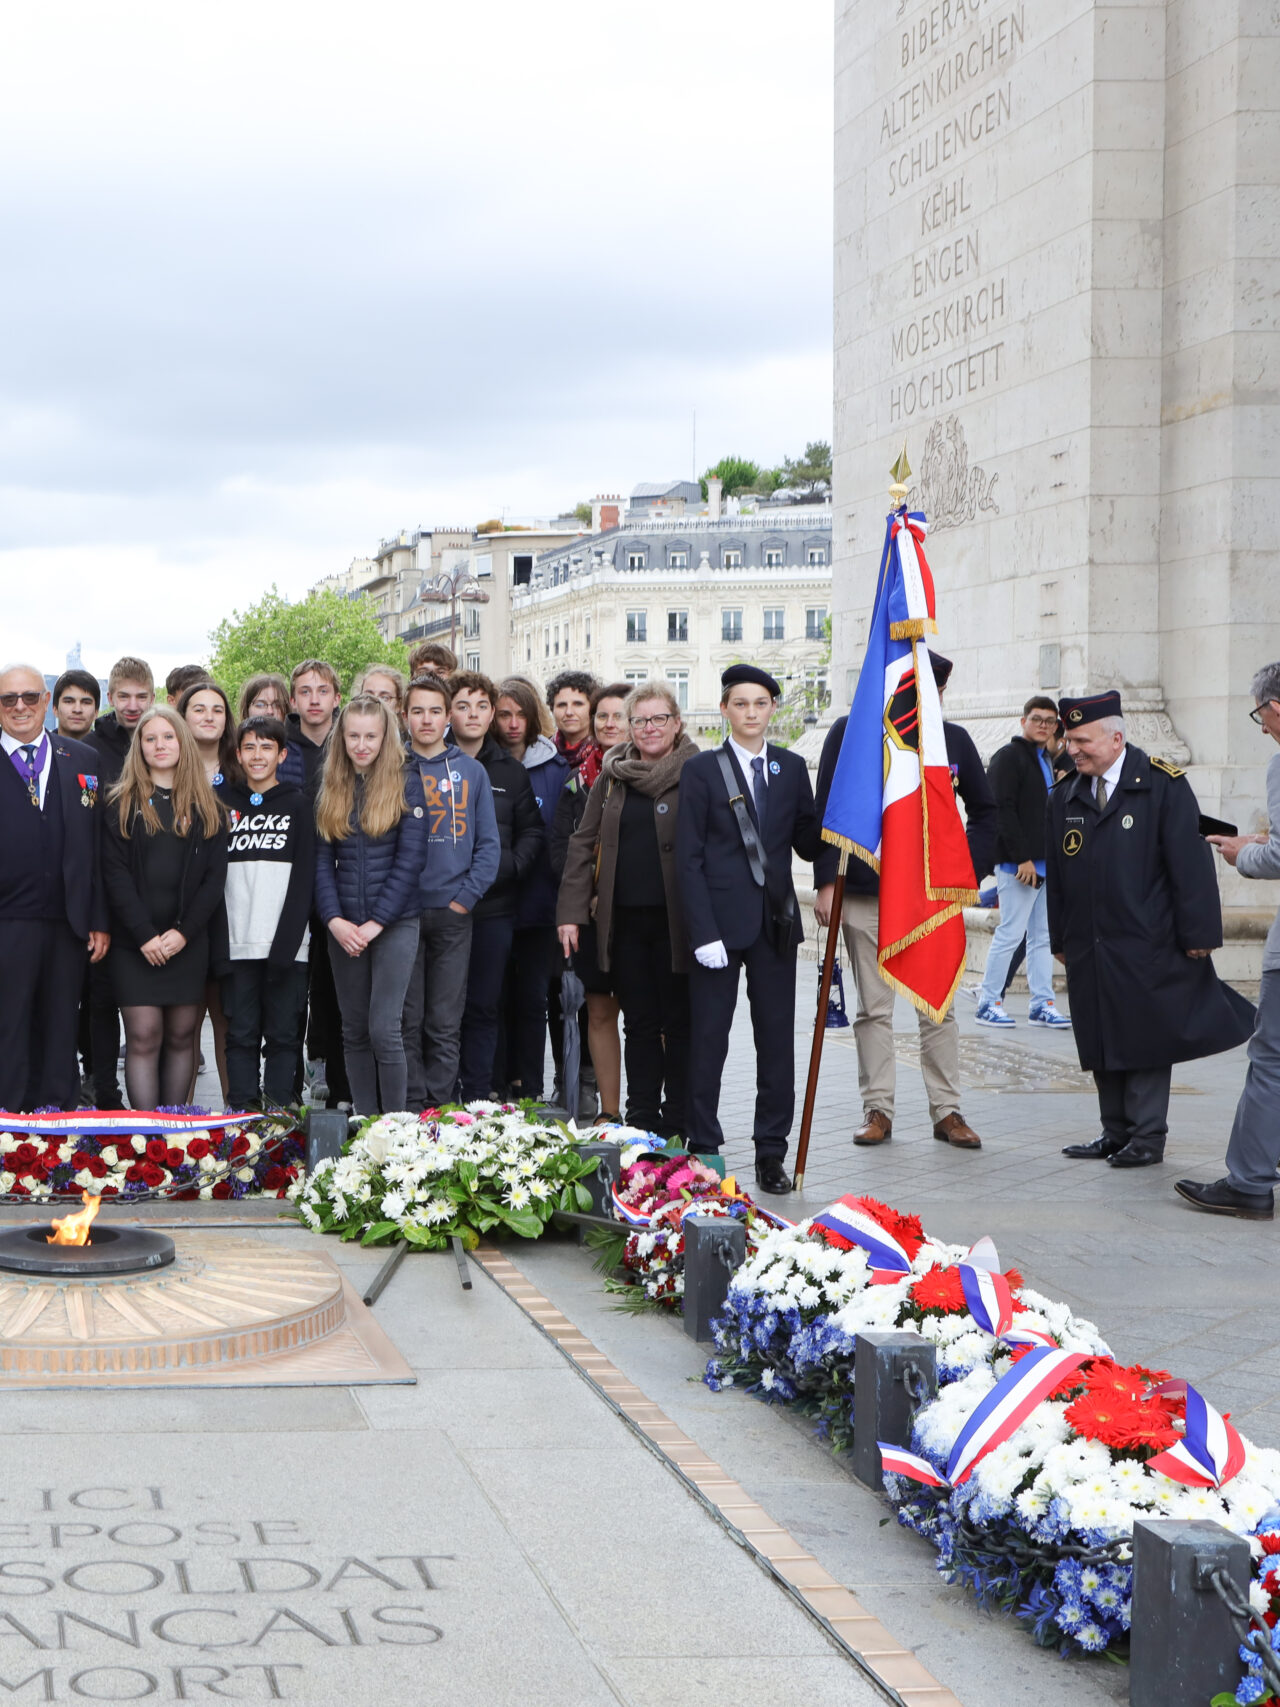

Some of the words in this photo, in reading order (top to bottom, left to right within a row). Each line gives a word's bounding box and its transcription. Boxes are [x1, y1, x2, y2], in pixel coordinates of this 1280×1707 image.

[901, 0, 988, 68] BIBERA
[880, 5, 1024, 144] ALTENKIRCHEN
[889, 81, 1012, 196] SCHLIENGEN
[921, 176, 971, 236] KEHL
[891, 278, 1005, 366] MOESKIRCH
[890, 341, 1005, 423] HOCHSTETT
[227, 833, 288, 852] JONES
[39, 1486, 167, 1512] ICI
